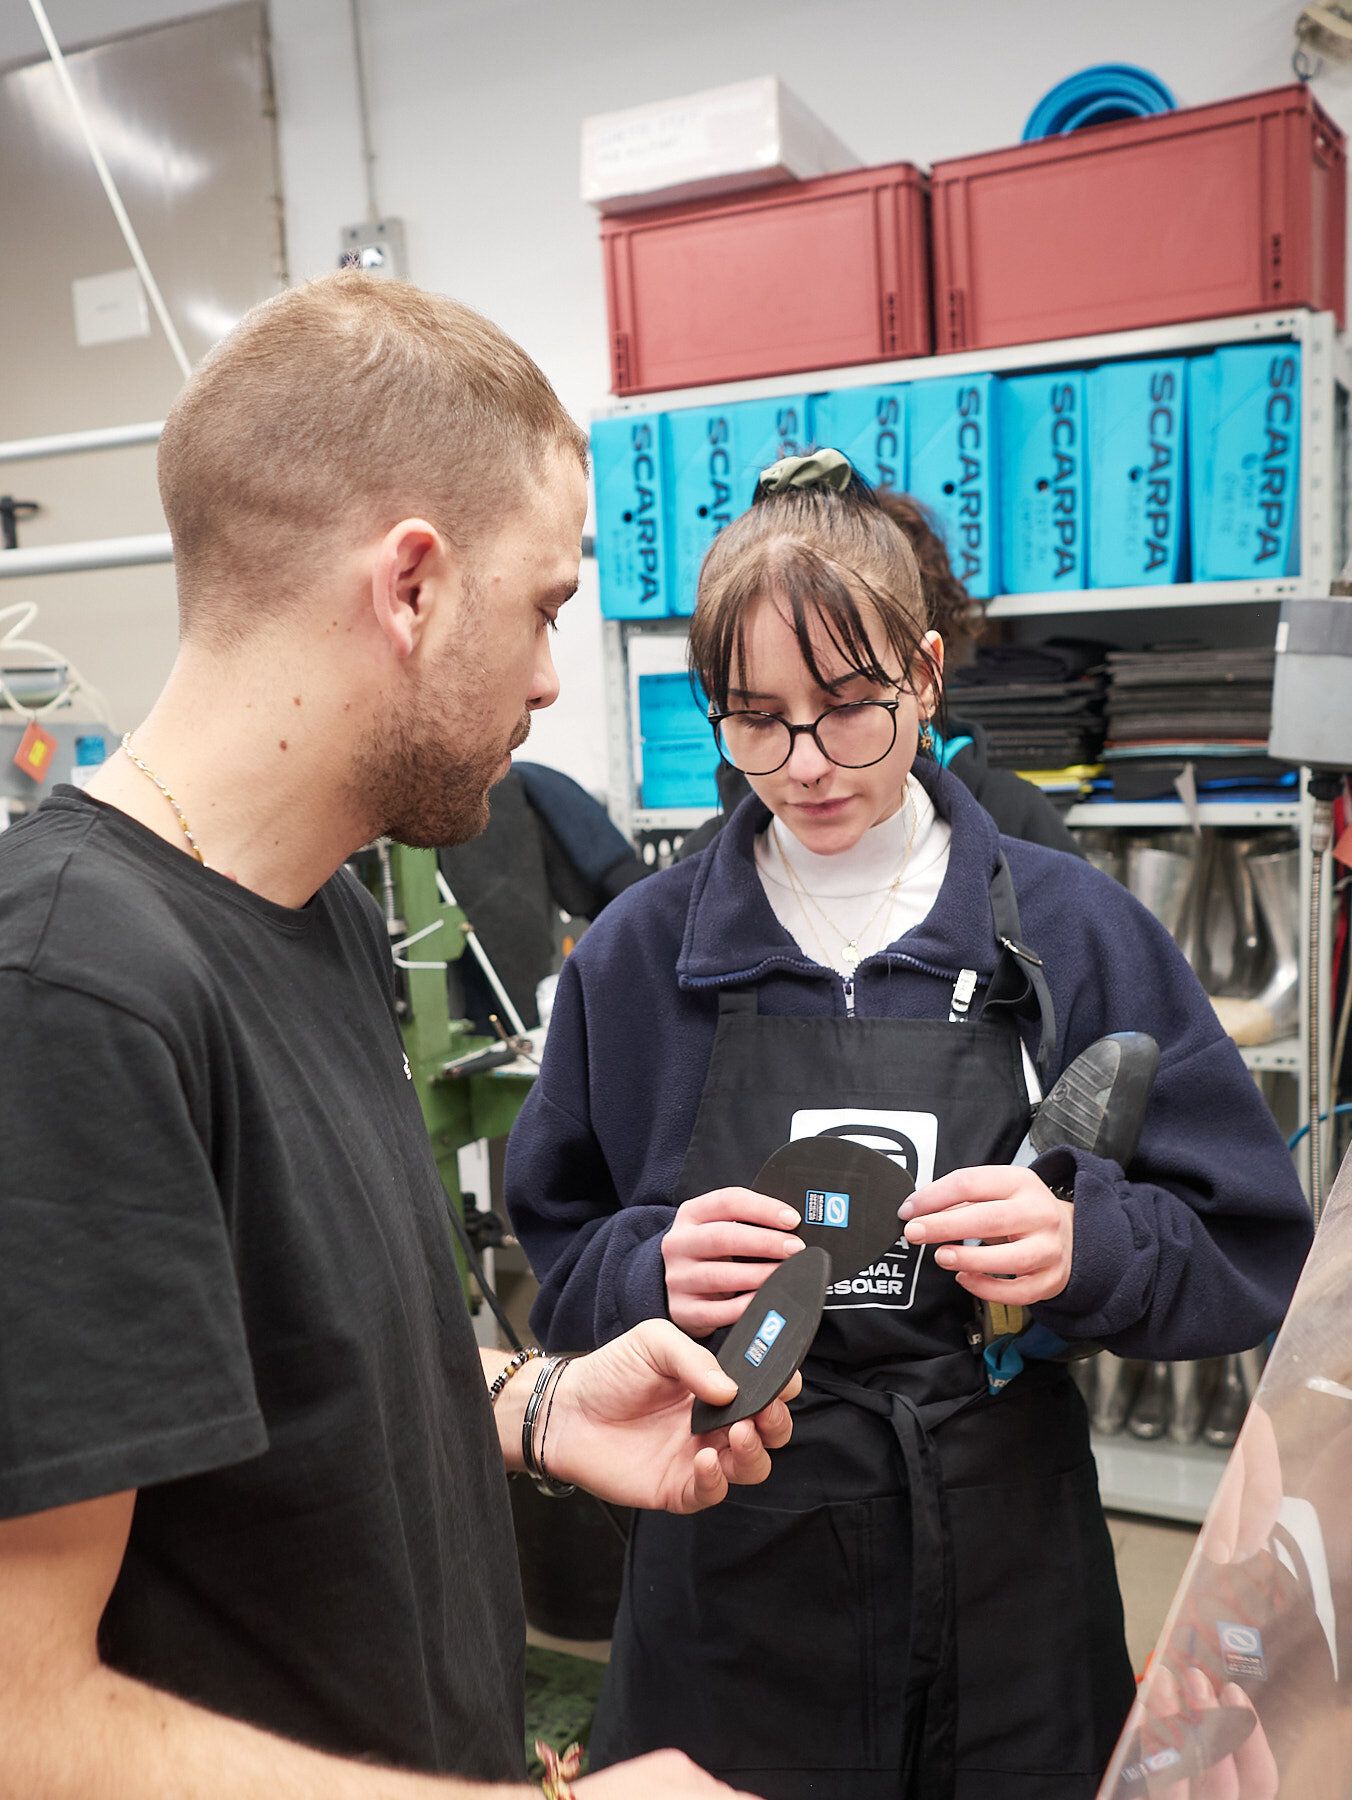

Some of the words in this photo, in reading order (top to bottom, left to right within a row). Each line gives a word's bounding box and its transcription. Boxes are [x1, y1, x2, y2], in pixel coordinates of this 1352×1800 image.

[632, 423, 660, 604] SCARPA
[957, 386, 982, 581] SCARPA
[1051, 382, 1077, 580] SCARPA
[1145, 370, 1175, 573] SCARPA
[1255, 354, 1296, 565] SCARPA
